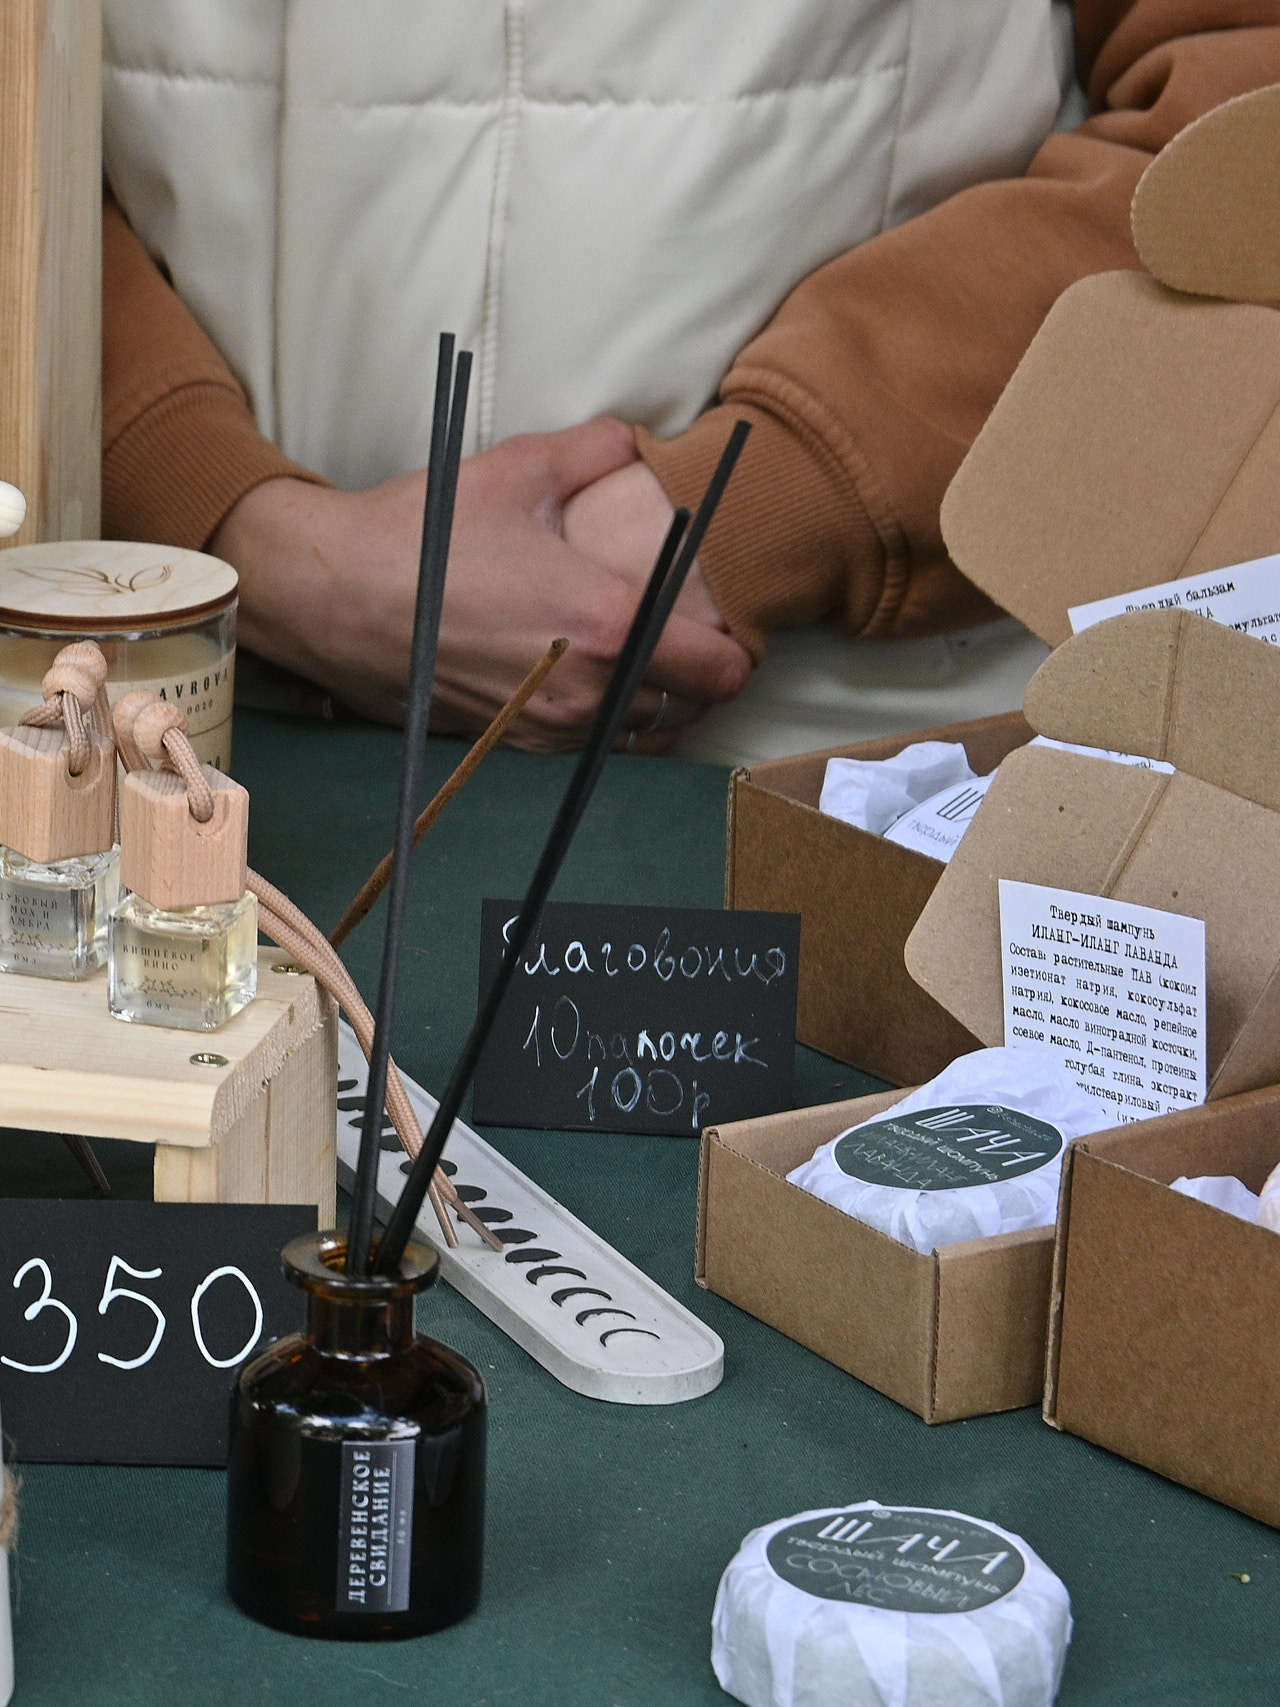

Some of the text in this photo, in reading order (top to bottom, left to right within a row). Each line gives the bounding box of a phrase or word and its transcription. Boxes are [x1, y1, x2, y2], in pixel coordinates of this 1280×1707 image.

[1186, 580, 1236, 602] бальзам
[159, 668, 228, 701] AVROVA
[9, 915, 50, 931] АМБРА
[10, 904, 35, 917] МОХ
[1049, 904, 1156, 942] Твердый шампунь
[123, 944, 195, 963] ВИШНЕВОЕ
[144, 959, 179, 971] ВИНО
[1053, 952, 1124, 978] растительные
[1131, 967, 1153, 985] ПАВ
[1158, 972, 1198, 997] (кокоил
[1124, 943, 1179, 970] ЛАВАНДА
[1010, 965, 1198, 1019] изетионат натрия, кокосульфат
[1012, 1005, 1045, 1024] масло,
[1049, 1013, 1080, 1031] масло
[1084, 1021, 1148, 1048] виноградной
[1060, 993, 1111, 1017] кокосовое
[1116, 1007, 1148, 1028] масло,
[1153, 1015, 1198, 1040] репейное
[1012, 1025, 1045, 1044] соевое
[1050, 1033, 1082, 1052] масло,
[1151, 1057, 1198, 1082] протеины
[1064, 1056, 1198, 1103] голубая глина, экстракт
[1, 1255, 263, 1374] 350
[348, 1450, 371, 1604] ДЕРЕВЕНСКОЕ
[369, 1466, 391, 1587] СВИДАНИЕ
